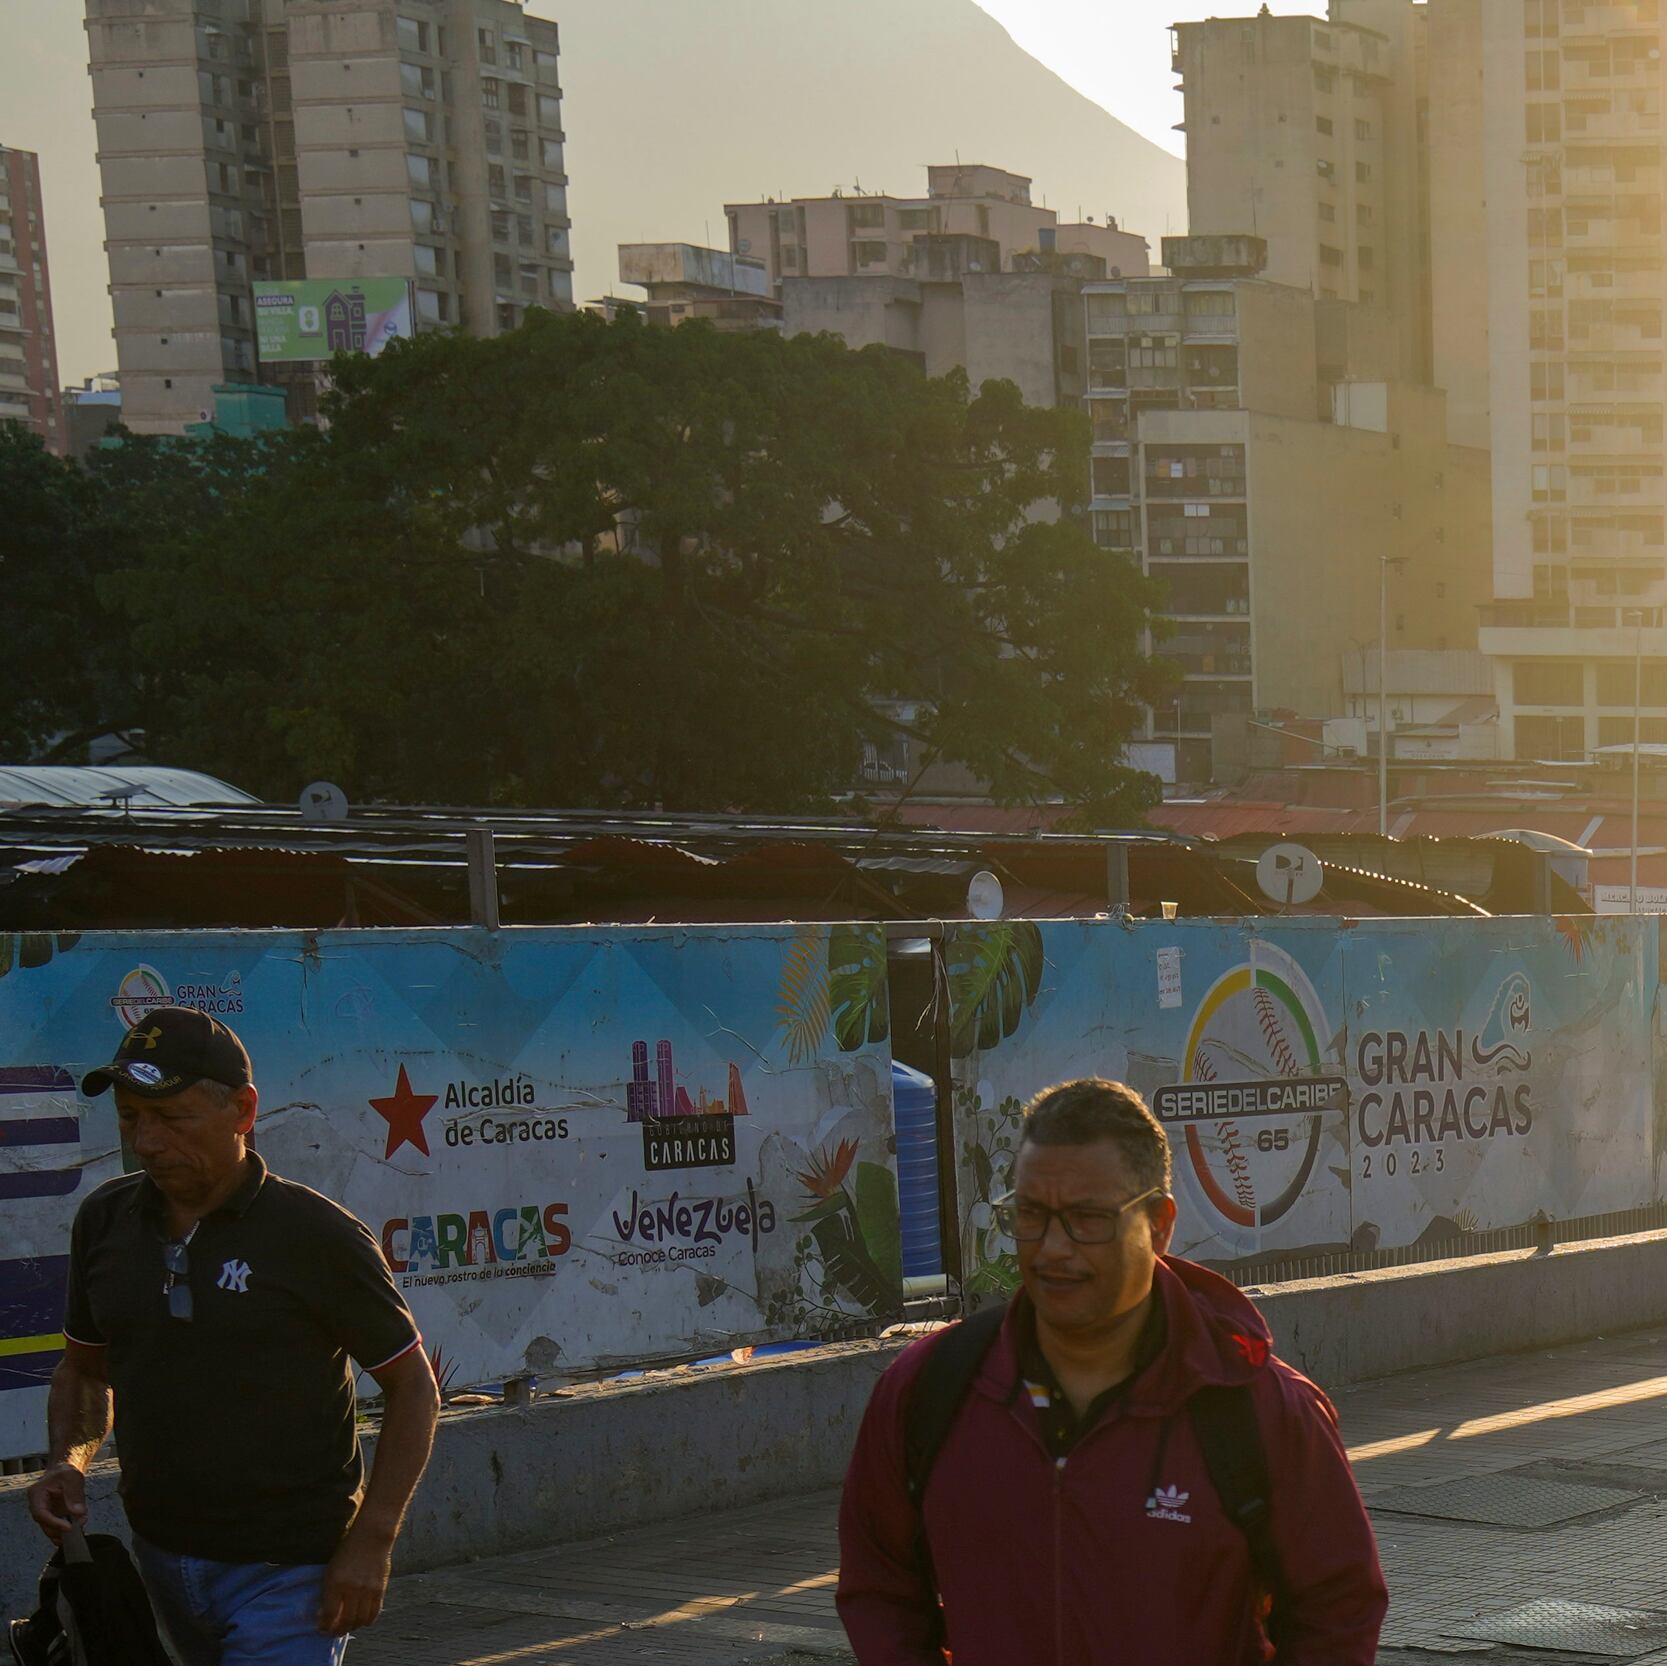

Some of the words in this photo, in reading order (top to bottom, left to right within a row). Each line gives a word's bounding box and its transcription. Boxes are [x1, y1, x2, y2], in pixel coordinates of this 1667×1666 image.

[177, 985, 216, 999] GRAN
[1358, 1029, 1463, 1086] GRAN
[444, 1073, 535, 1109] Alcaldía
[1358, 1083, 1532, 1148] CARACAS
[445, 1120, 473, 1147] de
[480, 1118, 569, 1144] Caracas
[1257, 1128, 1289, 1153] 65
[650, 1138, 730, 1164] CARACAS
[382, 1203, 572, 1273] CARACAS
[618, 1249, 666, 1266] Conoce
[668, 1245, 716, 1262] Caracas
[216, 1258, 253, 1294] NY
[403, 1276, 412, 1288] El
[414, 1274, 444, 1287] nuevo
[447, 1268, 477, 1283] rostro
[479, 1266, 491, 1280] de
[505, 1261, 556, 1276] conciencia
[1146, 1509, 1191, 1524] adidas
